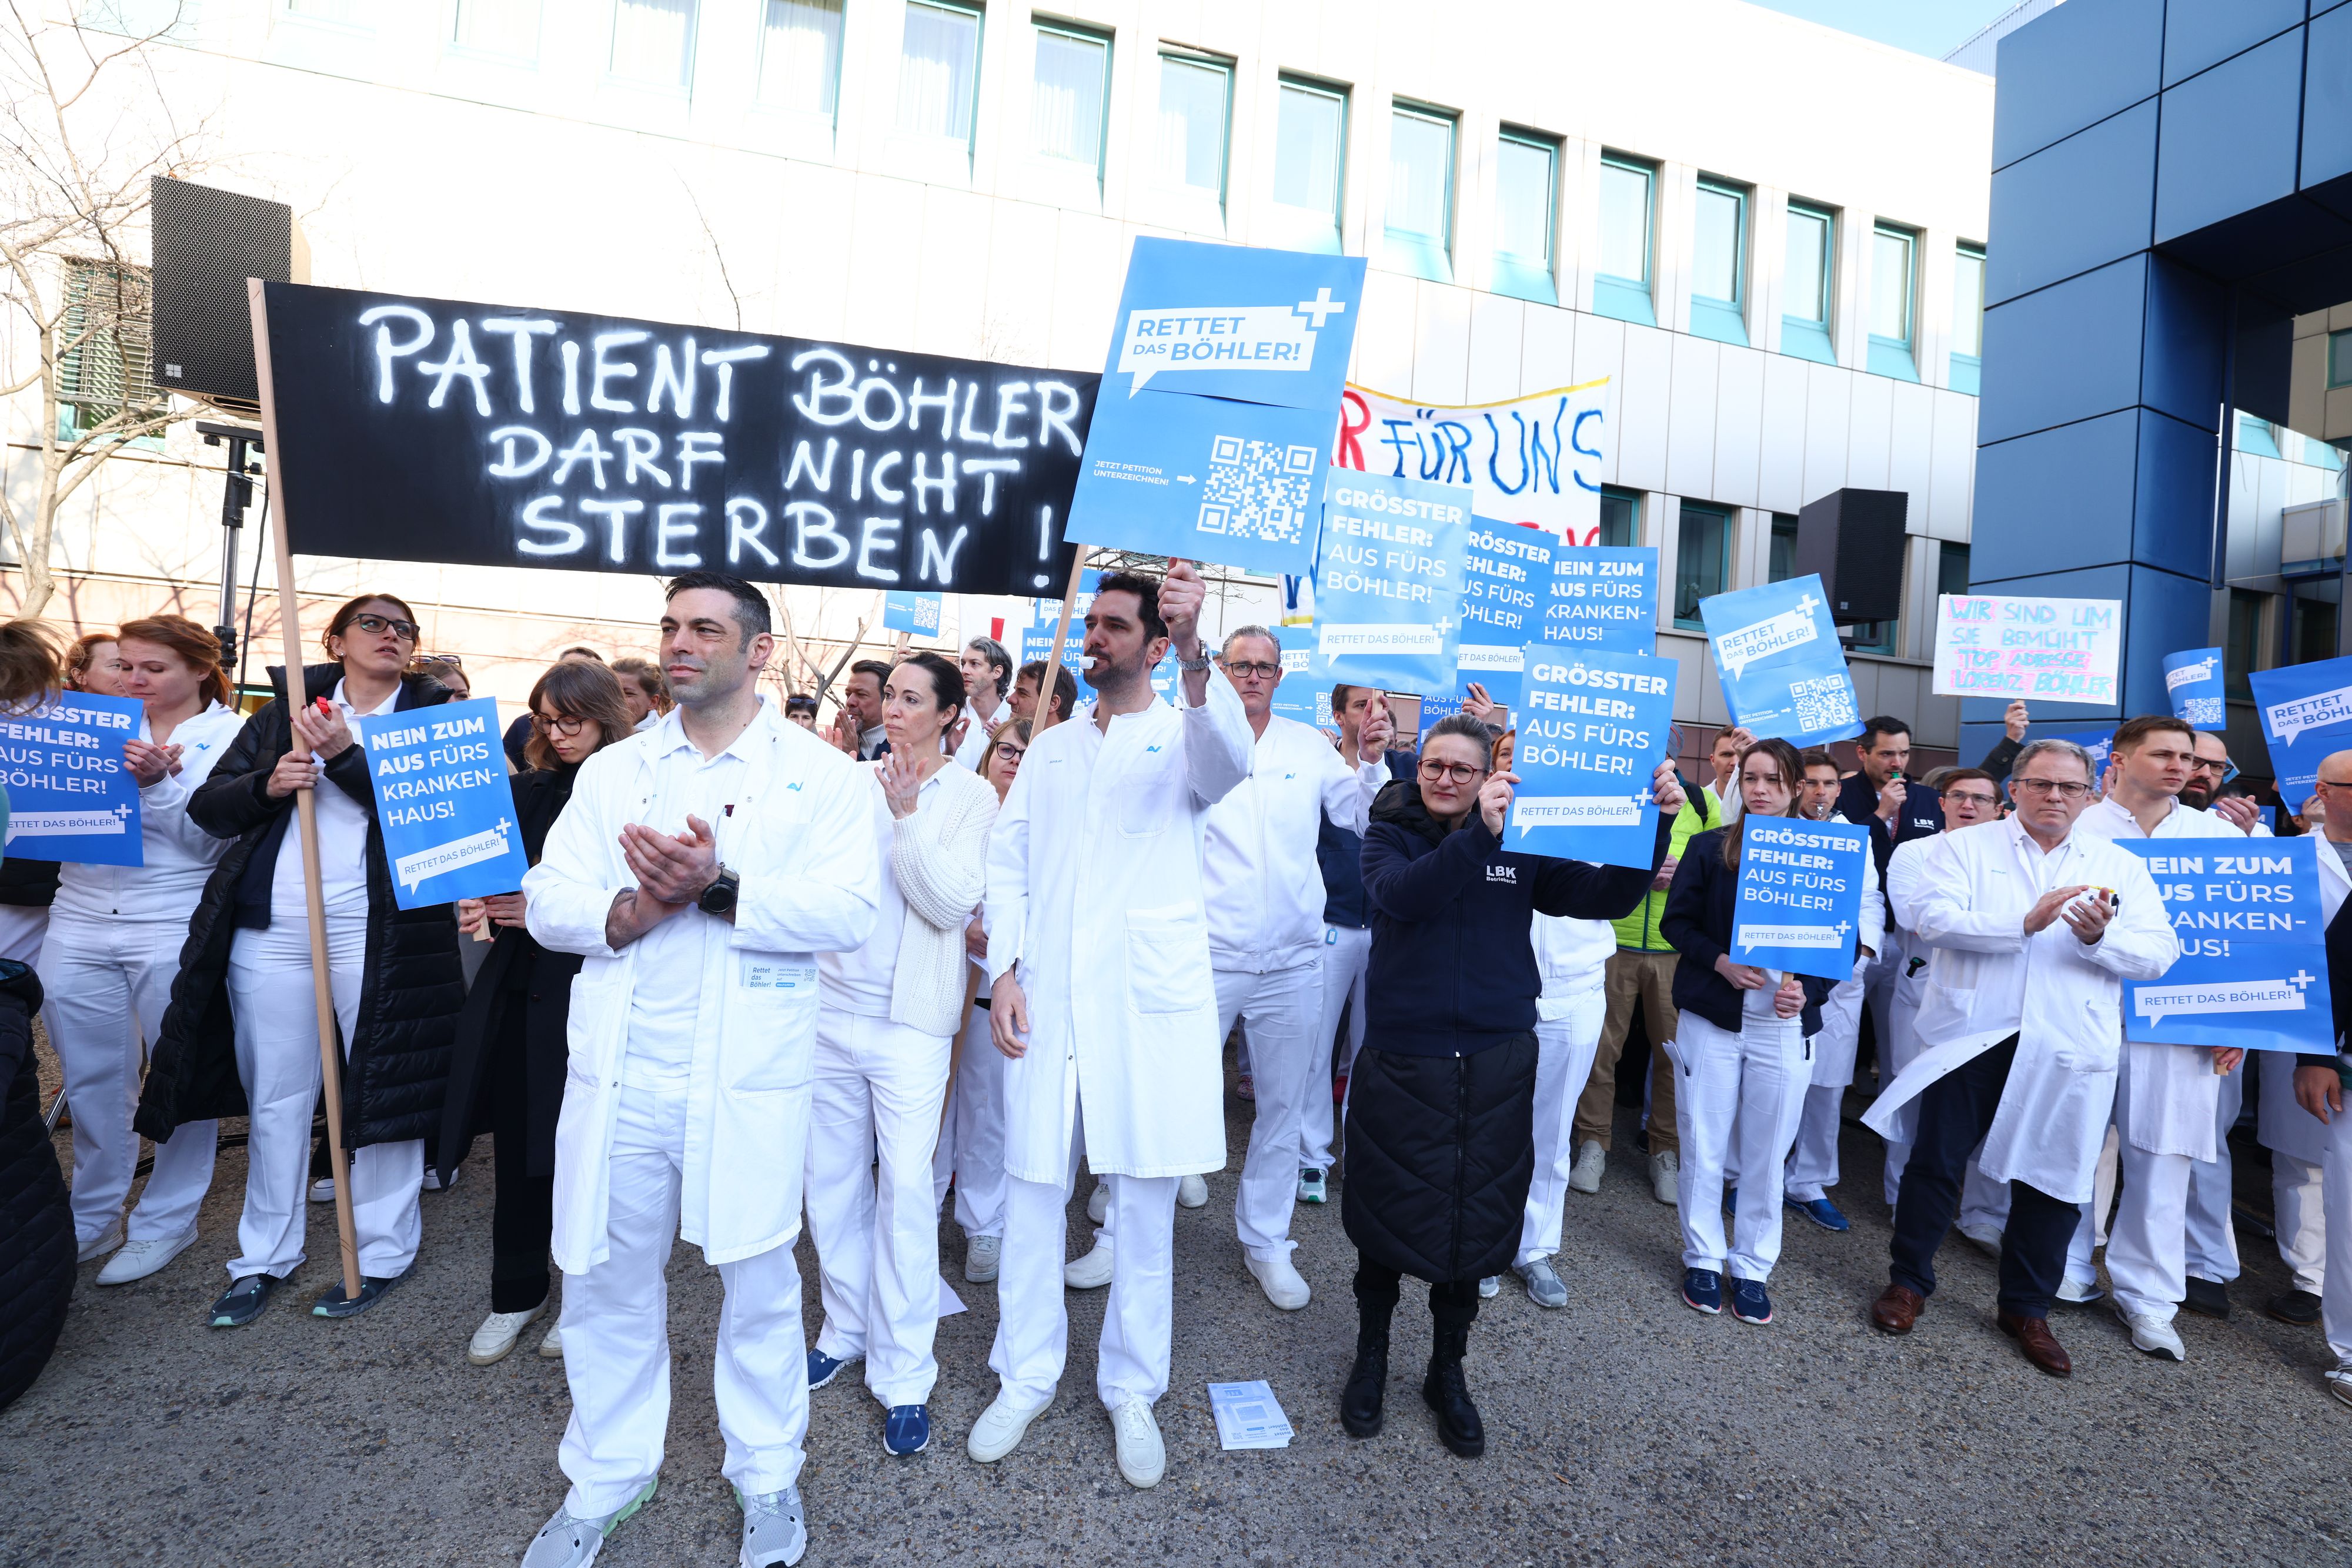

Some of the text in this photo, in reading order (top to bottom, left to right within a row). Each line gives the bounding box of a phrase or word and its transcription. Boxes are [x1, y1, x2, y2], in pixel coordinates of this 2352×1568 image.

[1137, 316, 1245, 337] RETTET
[1133, 337, 1301, 361] DAS BÖHLER!
[359, 305, 1082, 457] PATIENT BÖHLER
[1381, 408, 1473, 484] FÜR
[1484, 396, 1603, 495] UNS
[488, 426, 1020, 516] DARF NICHT
[1093, 469, 1169, 486] UNTERZEICHNEN!
[1095, 460, 1162, 475] JETZT PETITION
[1335, 488, 1463, 525] GRÖSSTER
[518, 495, 967, 584] STERBEN
[1332, 514, 1434, 547] FEHLER:
[1469, 530, 1551, 564] RÖSSTER
[1328, 543, 1446, 578] AUS FÜRS
[1466, 555, 1527, 583] EHLER:
[1599, 562, 1643, 576] ZUM
[1327, 569, 1432, 604] BÖHLER!
[1488, 583, 1535, 608] FÜRS
[1592, 580, 1642, 599] FÜRS
[1546, 604, 1647, 620] KRANKEN-
[1949, 598, 2112, 629] WIR SIND UM
[1327, 633, 1434, 644] RETTET DAS BÖHLER!
[1544, 626, 1603, 641] HAUS!
[1723, 623, 1775, 650] RETTET
[1726, 626, 1810, 660] DAS BÖHLER!
[1949, 627, 2099, 650] SIE BEMÜHT
[1470, 653, 1486, 661] DAS
[1488, 653, 1521, 663] BÖHLER!
[1958, 648, 2086, 668] TOP ADRESSE
[1532, 663, 1668, 696] GRÖSSTER
[1955, 669, 2113, 700] LORENZ BÖHLER
[1529, 690, 1636, 720] FEHLER:
[2274, 694, 2342, 718] RETTET
[2278, 705, 2352, 727] DAS BÖHL
[1739, 713, 1779, 724] UNTERZEICHNEN!
[371, 716, 485, 751] NEIN ZUM
[1524, 718, 1650, 750] AUS FÜRS
[51, 751, 119, 773] FÜRS
[377, 744, 489, 777] AUS FÜRS
[1522, 744, 1633, 776] BÖHLER!
[382, 767, 499, 801] KRANKEN-
[387, 800, 455, 827] HAUS!
[1521, 804, 1633, 816] RETTET DAS BÖHLER!
[69, 818, 116, 827] BÖHLER!
[1914, 818, 1934, 827] LBK
[1750, 828, 1861, 852] GRÖSSTER
[405, 838, 500, 875] RETTET DAS BÖHLER!
[1748, 848, 1834, 870] FEHLER:
[2214, 857, 2293, 875] ZUM
[1486, 865, 1516, 878] LBK
[1486, 876, 1516, 884] Betriebsrat
[1745, 868, 1846, 892] AUS FÜRS
[1744, 887, 1833, 911] BÖHLER!
[2157, 880, 2294, 903] US FÜRS
[1798, 931, 1835, 941] BÖHLER!
[2180, 938, 2231, 957] US!
[2144, 990, 2291, 1006] RETTET DAS BÖHLER!
